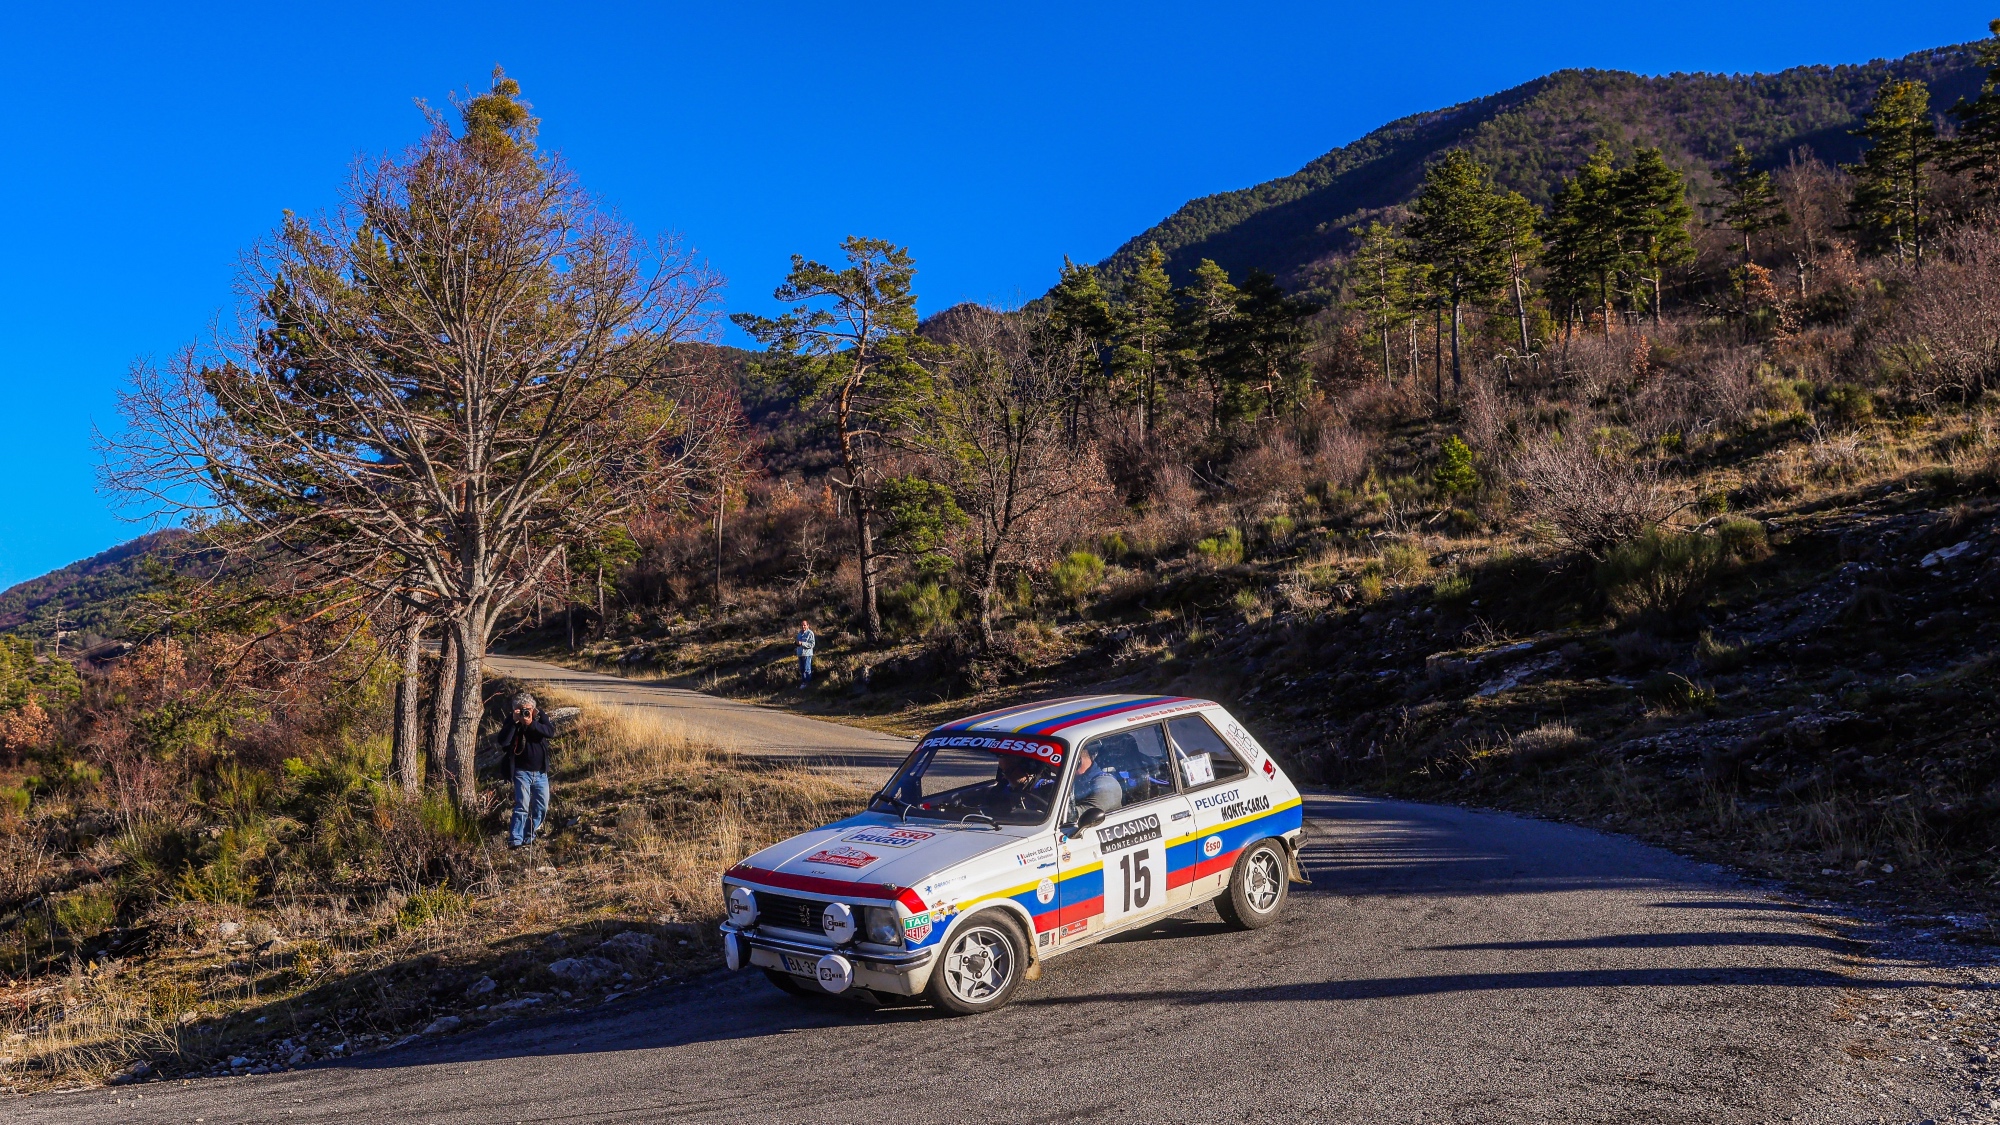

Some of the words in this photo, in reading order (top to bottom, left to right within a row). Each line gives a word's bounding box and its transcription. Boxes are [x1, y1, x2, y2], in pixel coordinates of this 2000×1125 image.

[922, 736, 993, 750] PEUGEOT
[999, 739, 1054, 757] ESSO
[1194, 789, 1240, 811] PEUGEOT
[1221, 795, 1270, 822] MONTE-CARLO
[849, 833, 916, 846] PEUGEOT
[1098, 828, 1112, 844] LE
[1113, 816, 1158, 839] CASINO
[1120, 848, 1151, 913] 15
[906, 915, 929, 928] TAG
[905, 925, 929, 941] HEUER
